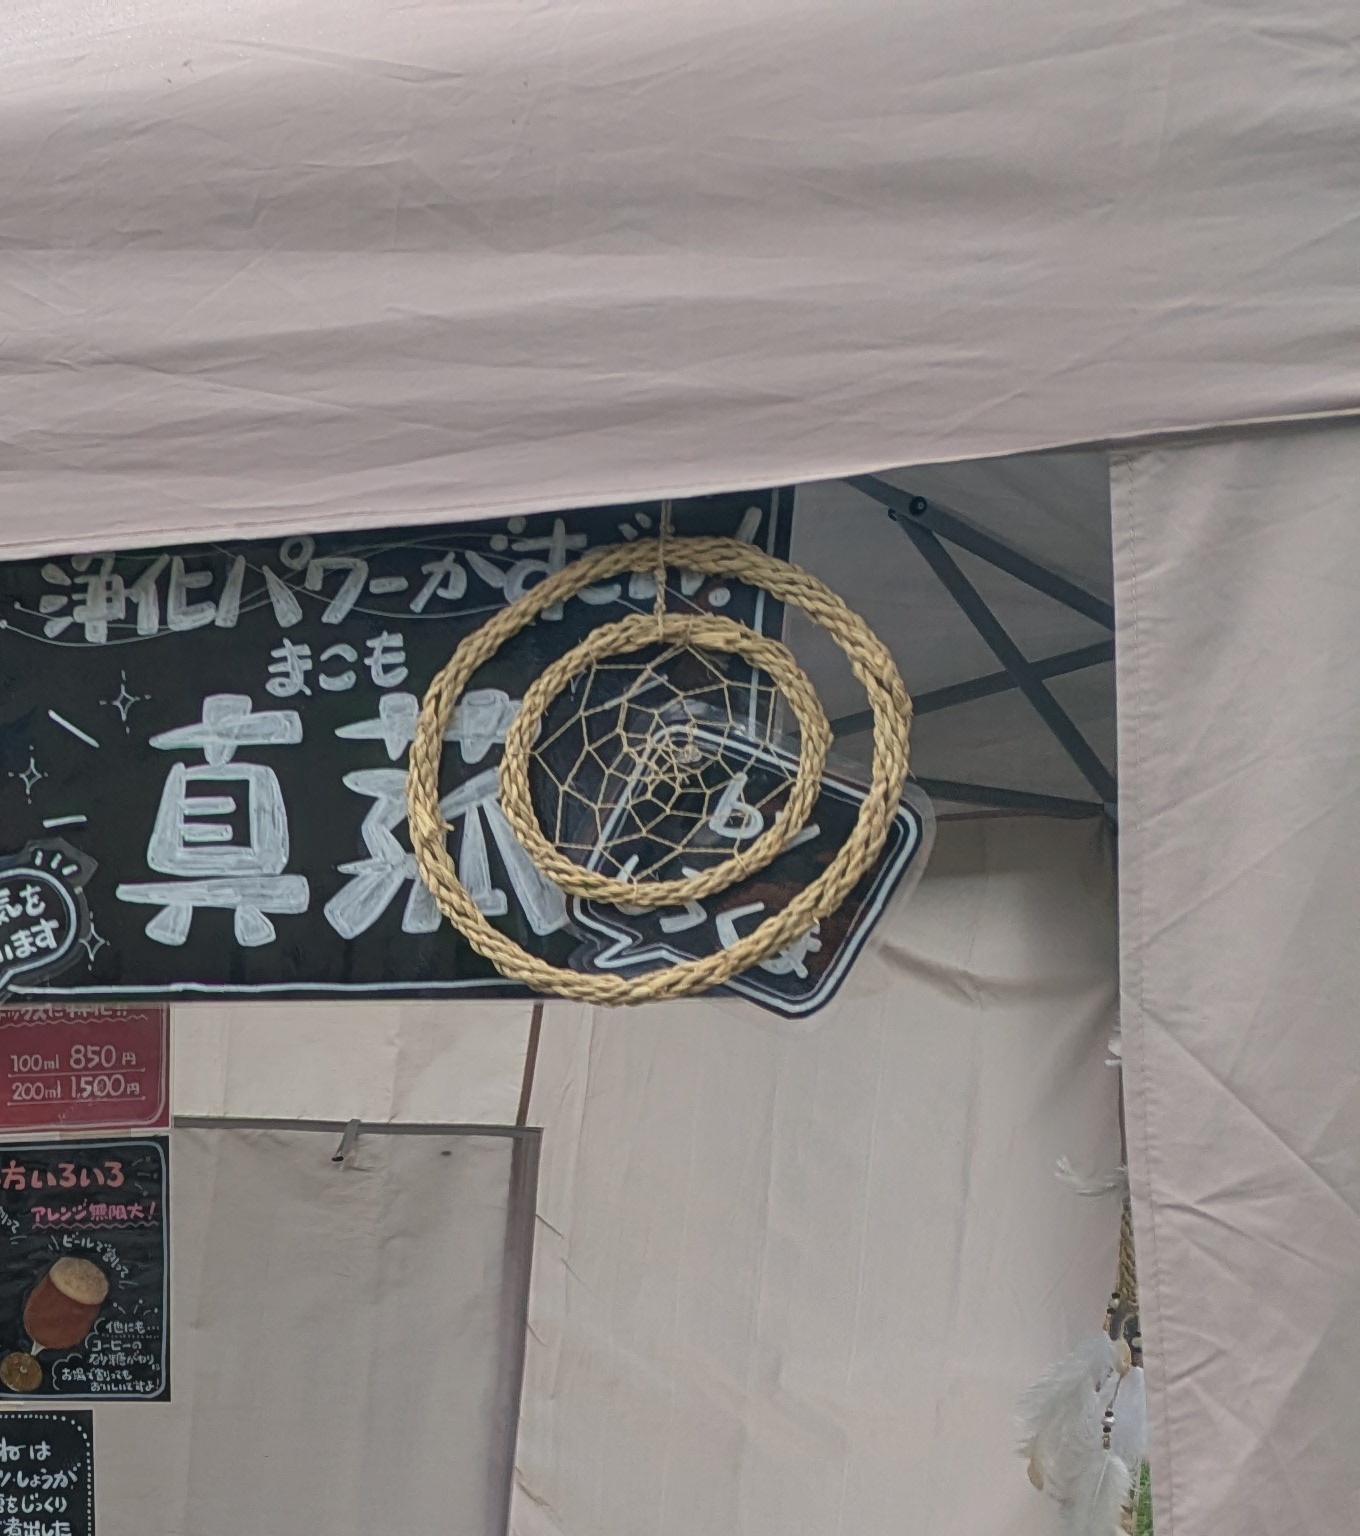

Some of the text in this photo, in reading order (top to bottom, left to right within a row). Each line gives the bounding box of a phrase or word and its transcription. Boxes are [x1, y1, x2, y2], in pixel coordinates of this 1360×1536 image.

[266, 632, 409, 697] まこも
[11, 1053, 60, 1073] 100ml
[12, 1079, 62, 1101] 200ml
